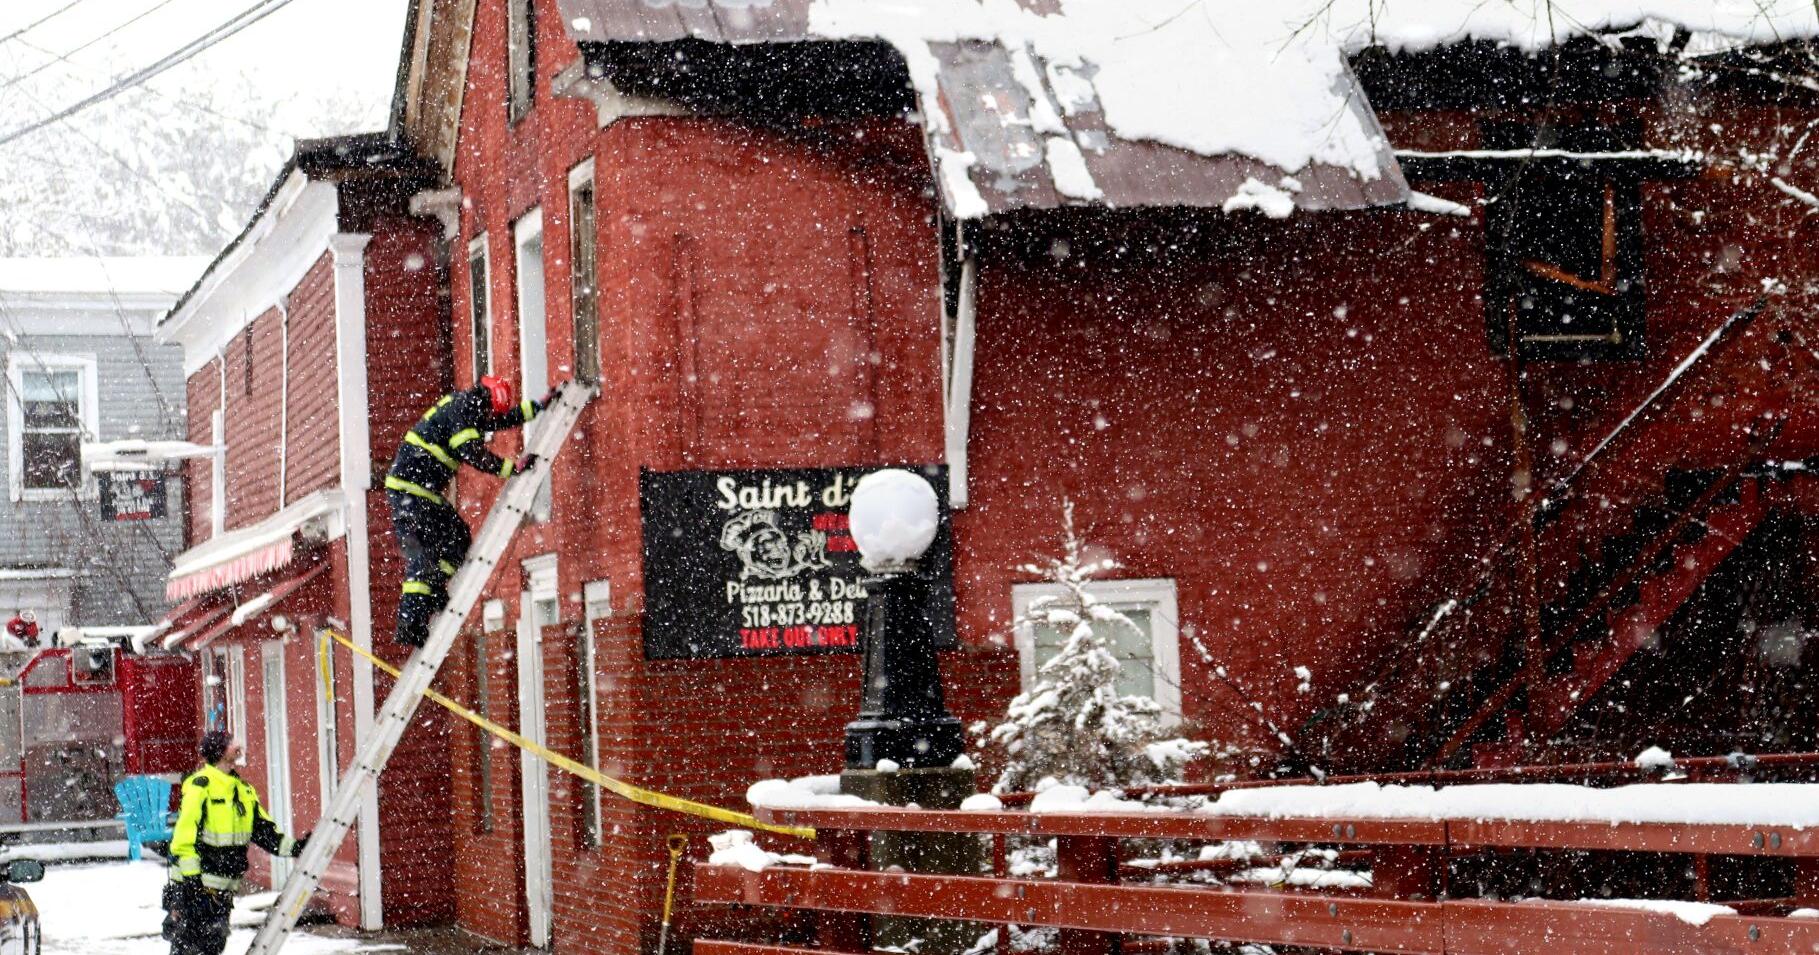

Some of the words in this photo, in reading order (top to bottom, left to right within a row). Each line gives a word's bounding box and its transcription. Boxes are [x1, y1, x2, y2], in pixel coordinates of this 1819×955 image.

[717, 476, 812, 509] Saint
[823, 474, 854, 507] d'
[727, 579, 804, 604] Pizzaria
[809, 578, 823, 600] &
[742, 601, 854, 627] 518-873-9288
[739, 627, 779, 648] TAKE
[784, 625, 813, 648] OUT
[818, 625, 857, 647] ONLY
